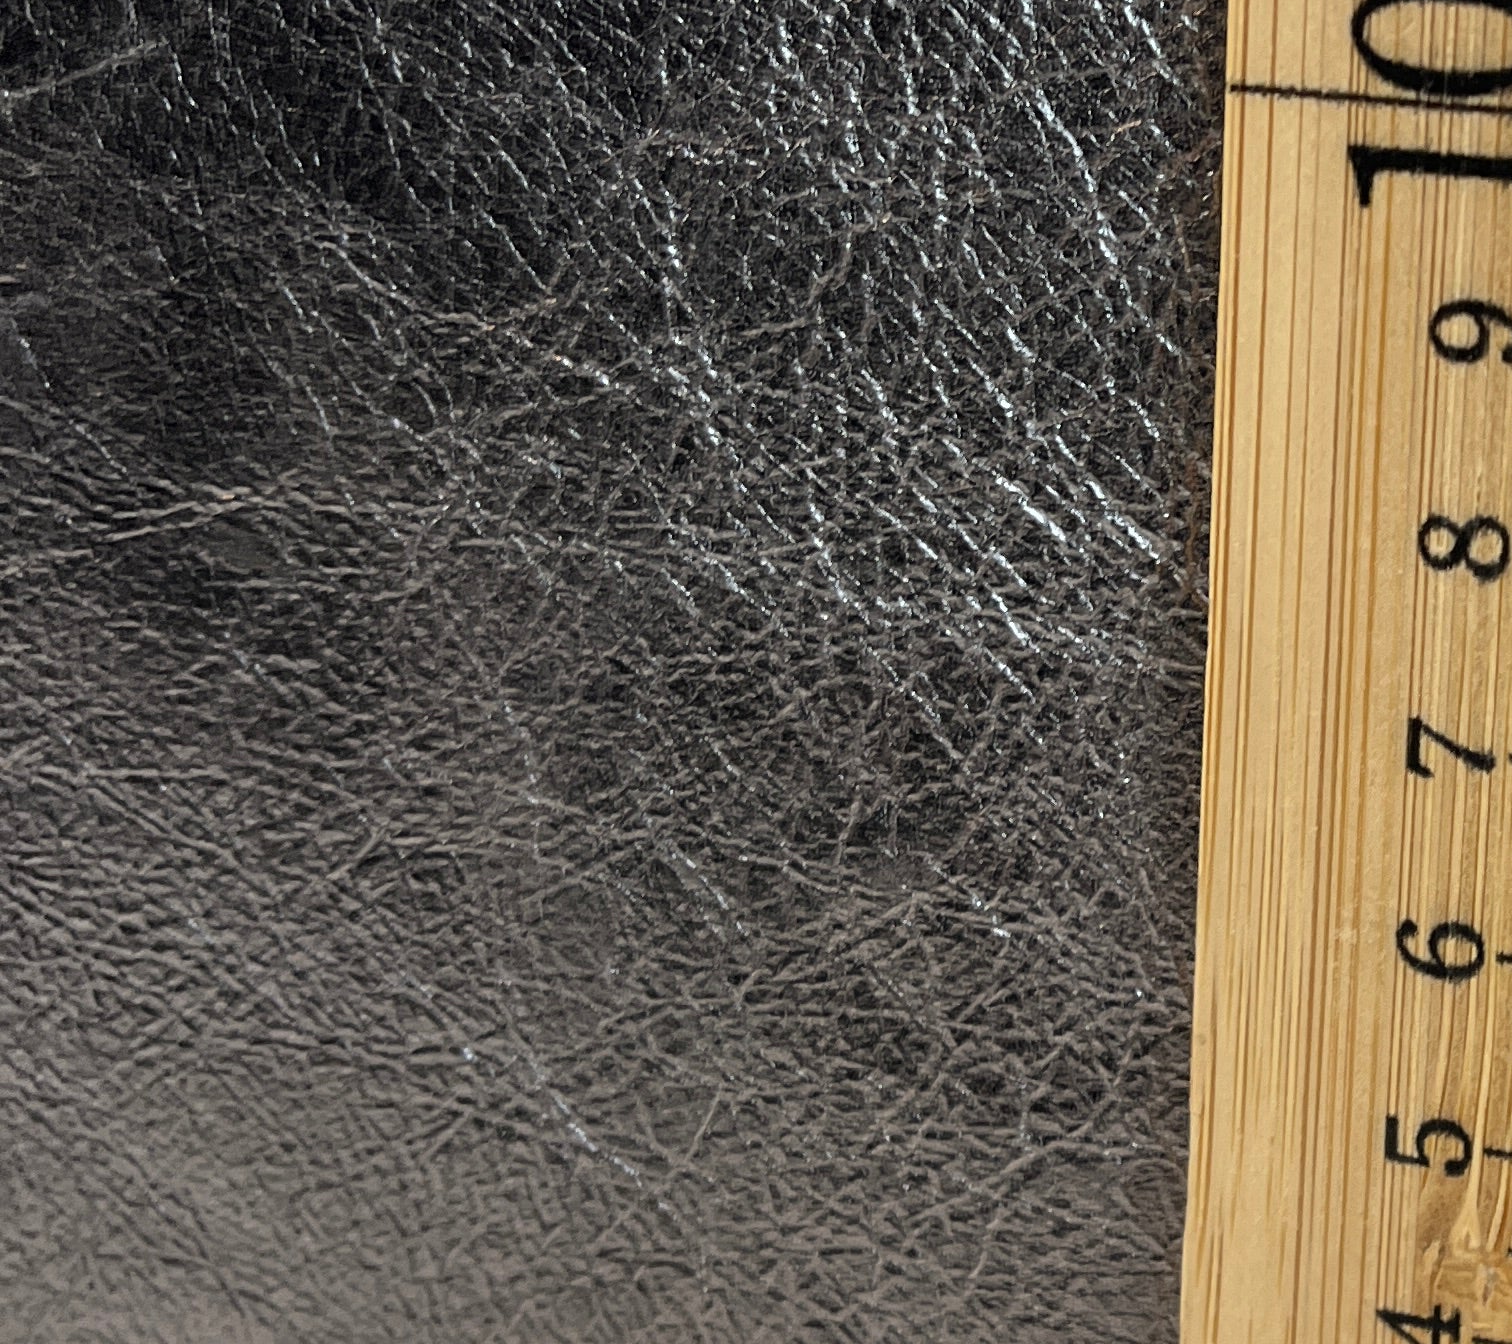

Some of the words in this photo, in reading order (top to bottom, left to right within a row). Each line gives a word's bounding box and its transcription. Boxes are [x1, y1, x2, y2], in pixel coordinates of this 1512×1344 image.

[1416, 513, 1512, 583] 8
[1405, 716, 1497, 779] 7
[1395, 917, 1486, 985] 6
[1383, 1113, 1474, 1178] 5
